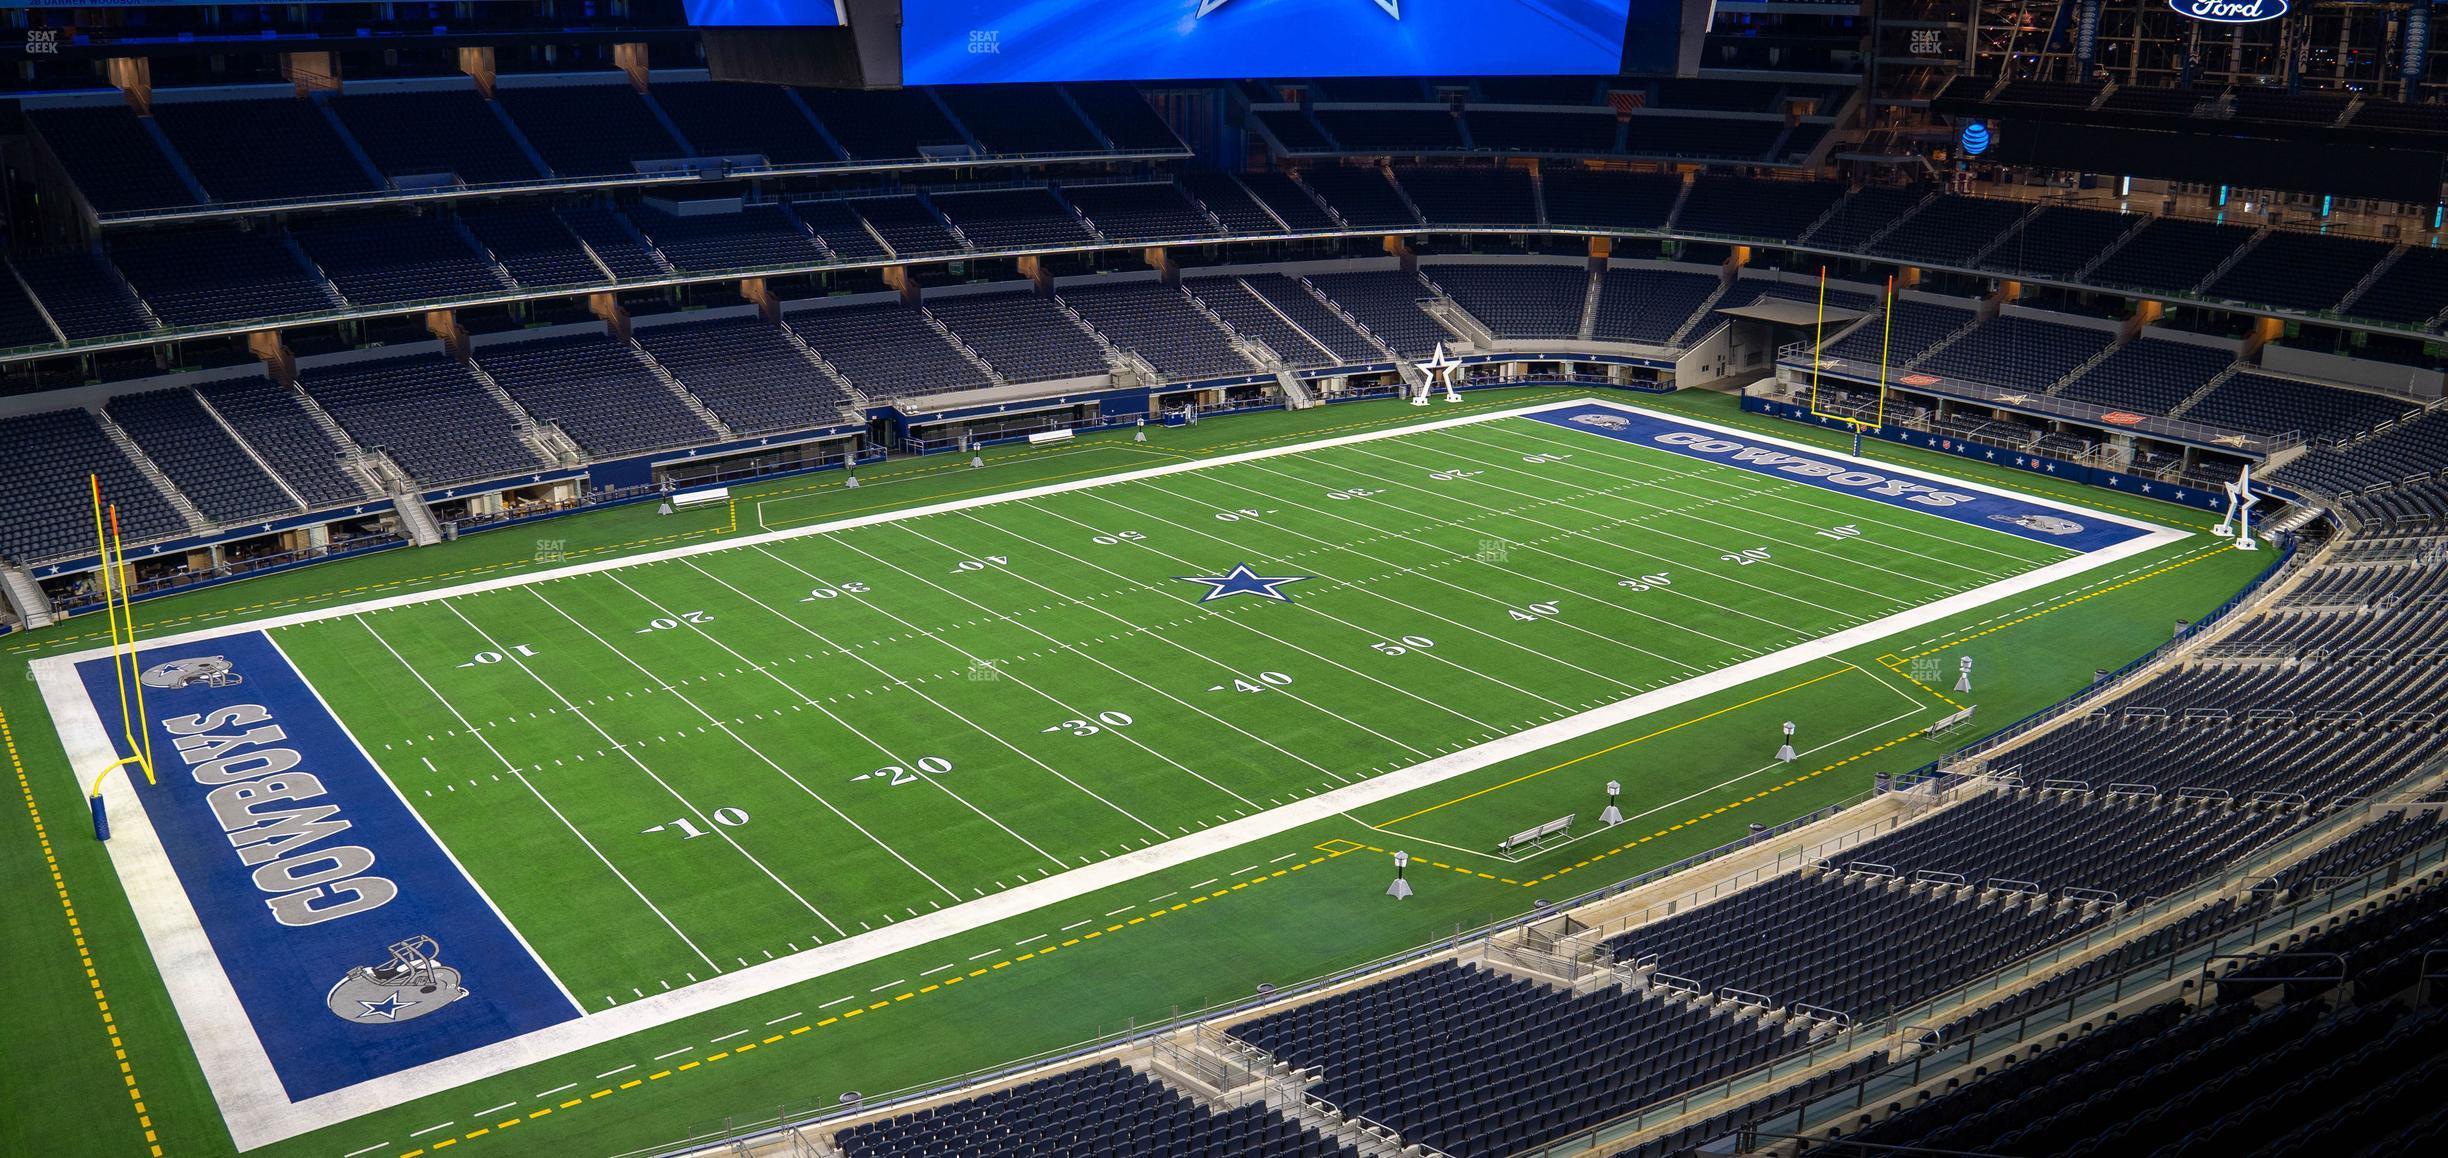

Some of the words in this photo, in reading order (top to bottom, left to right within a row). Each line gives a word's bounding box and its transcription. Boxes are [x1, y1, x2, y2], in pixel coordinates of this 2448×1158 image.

[2192, 0, 2264, 17] Ford
[1523, 453, 1561, 463] 10
[1430, 469, 1473, 481] 20
[1653, 431, 1977, 508] COWBOYS
[1327, 488, 1373, 500] 30
[1215, 509, 1259, 521] 40
[1092, 531, 1147, 545] 50
[1816, 526, 1861, 540] 10
[959, 556, 1007, 570] 40
[1720, 549, 1771, 565] 20
[812, 582, 870, 599] 30
[1618, 574, 1671, 591] 30
[651, 610, 714, 630] 20
[1509, 604, 1560, 621] 40
[474, 643, 540, 664] 10
[1371, 636, 1434, 656] 50
[1234, 672, 1292, 693] 40
[1063, 711, 1133, 736] 30
[875, 756, 952, 786] 20
[161, 703, 398, 927] COWBOYS
[668, 807, 749, 840] 10
